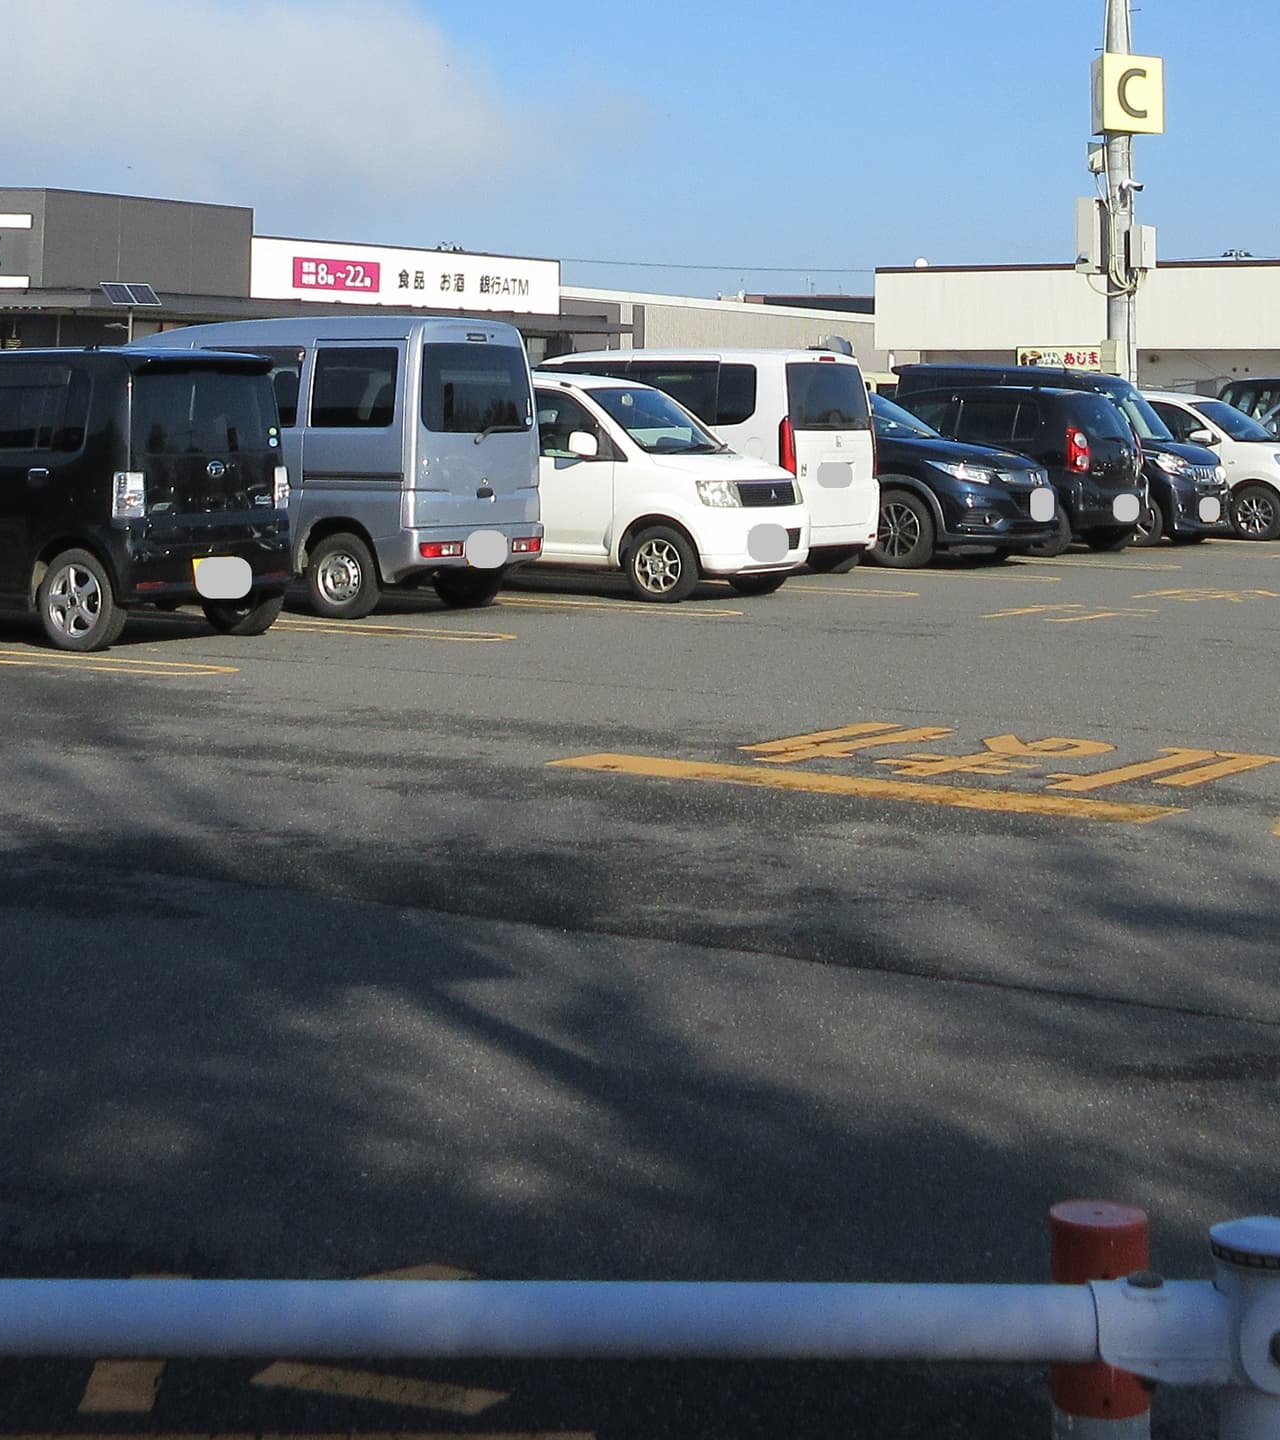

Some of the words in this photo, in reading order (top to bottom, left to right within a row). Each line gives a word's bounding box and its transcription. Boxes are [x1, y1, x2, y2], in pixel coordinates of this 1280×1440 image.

[1117, 68, 1148, 119] C
[398, 268, 425, 290] 食品
[440, 272, 465, 293] お酒
[479, 275, 529, 296] 銀行ATM
[1063, 351, 1099, 365] あじま
